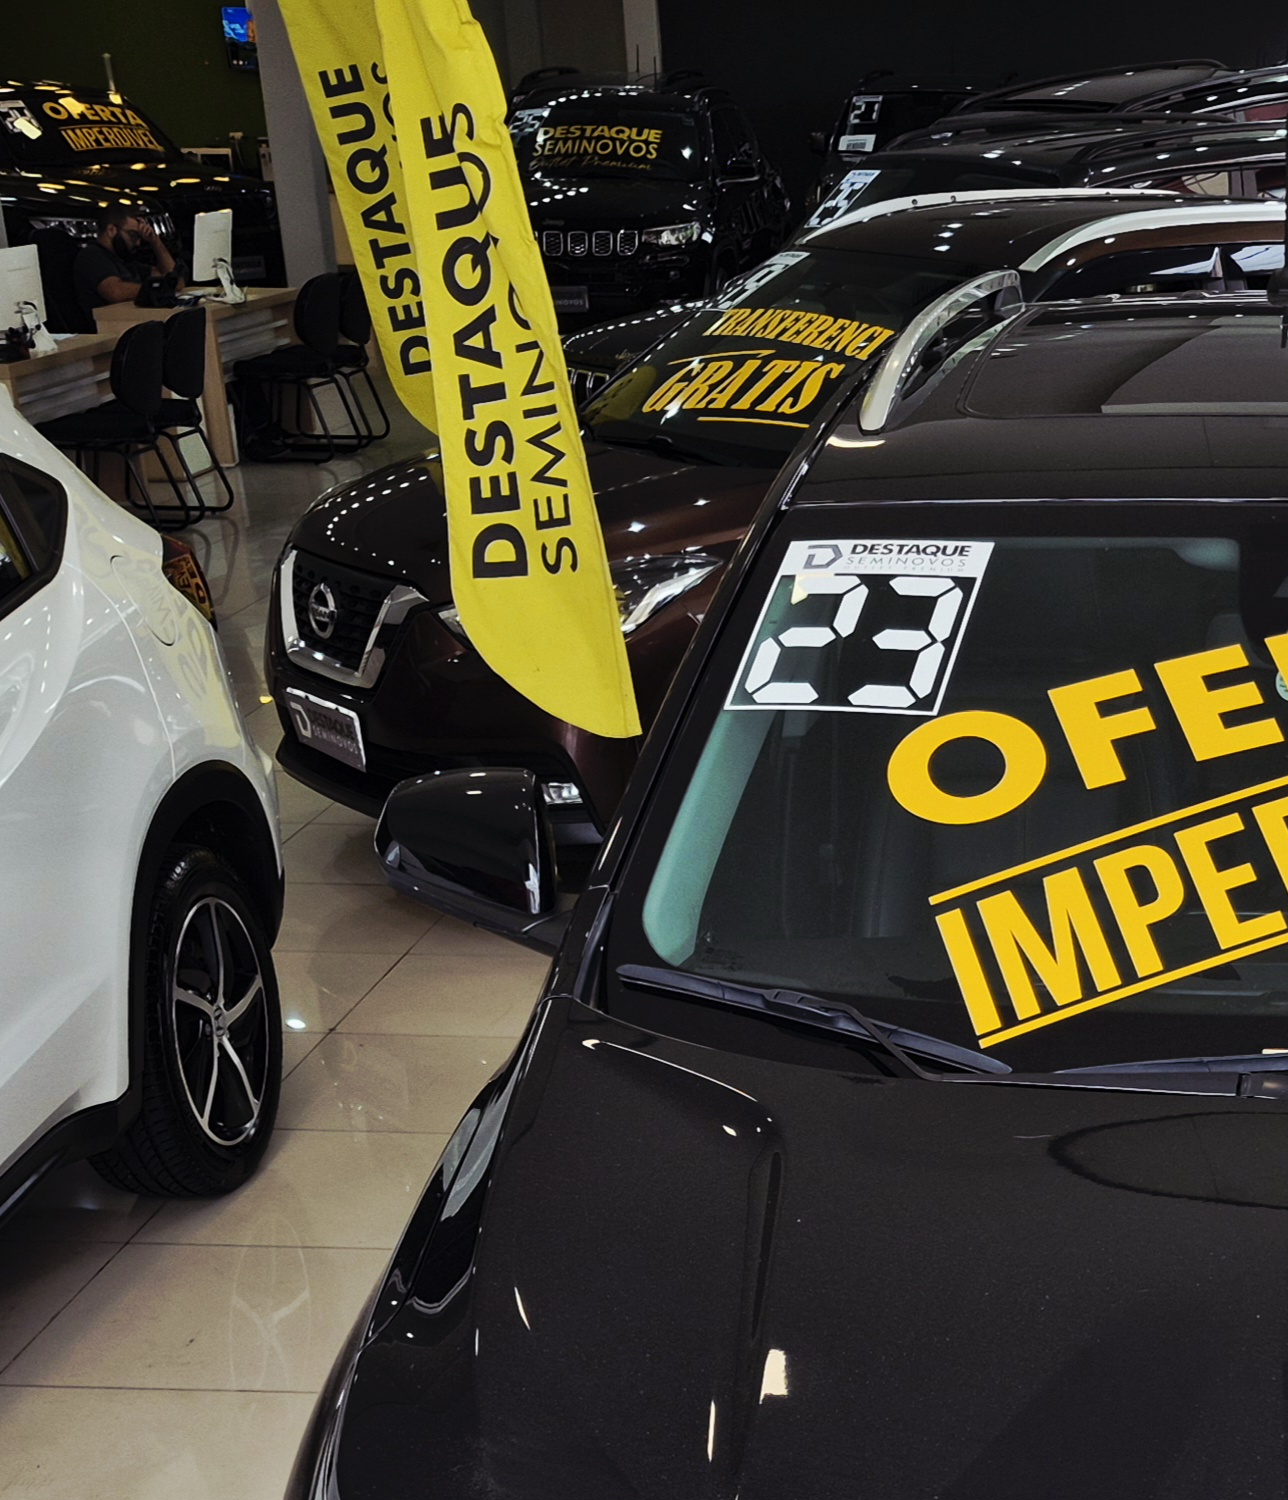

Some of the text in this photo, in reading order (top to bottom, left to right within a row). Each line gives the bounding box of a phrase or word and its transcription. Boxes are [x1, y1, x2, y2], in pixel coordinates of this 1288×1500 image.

[849, 101, 880, 124] 21
[536, 124, 664, 143] DESTAQUE
[532, 138, 659, 160] SEMINOVOS
[317, 64, 433, 376] DESTAQUE
[420, 111, 529, 579] DESTAQUE
[702, 307, 895, 361] TRANSFERENCI
[845, 556, 967, 568] SEMINOVOS
[849, 543, 973, 558] DESTAQUE
[744, 574, 964, 709] 23
